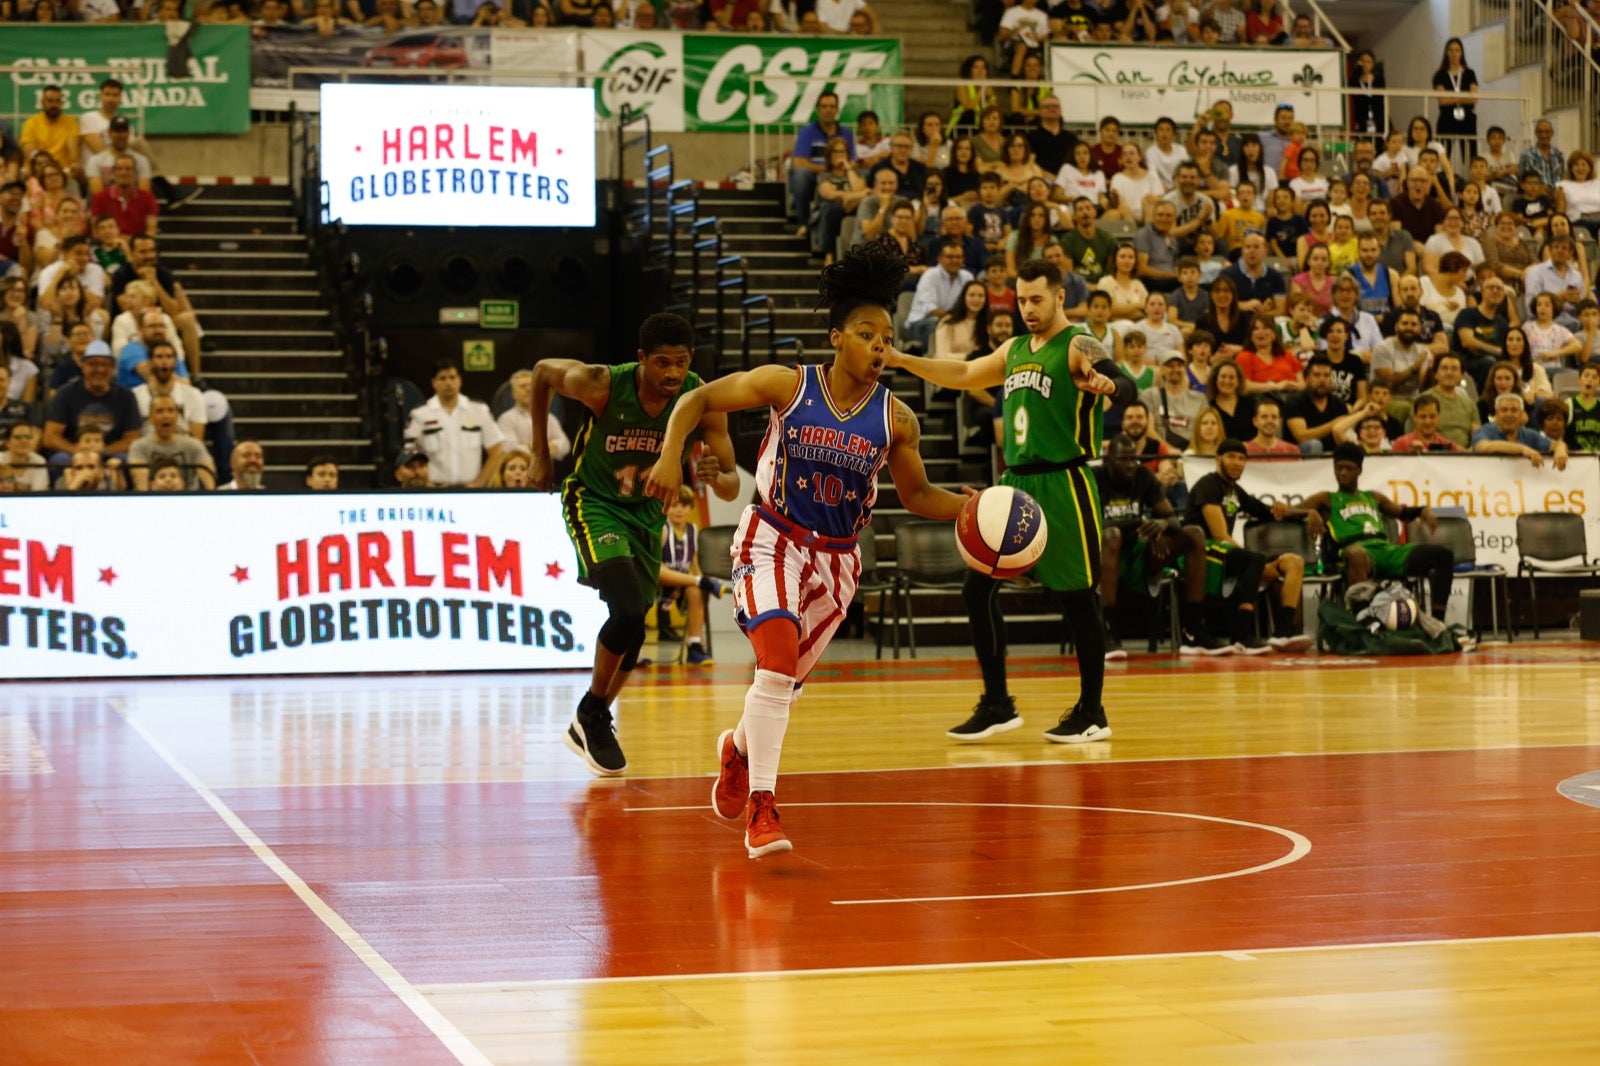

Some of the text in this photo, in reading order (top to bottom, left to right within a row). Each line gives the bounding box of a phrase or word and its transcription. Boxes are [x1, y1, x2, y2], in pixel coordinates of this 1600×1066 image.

[10, 56, 228, 86] CAJA RUAL
[607, 66, 677, 94] CSIF
[697, 44, 888, 123] CSIF
[1072, 51, 1279, 118] San Cayetano
[79, 86, 206, 110] GANADA
[383, 124, 538, 168] HARLEM
[351, 168, 570, 205] GLOBETROTTERS
[623, 429, 666, 440] WASHINGT
[799, 425, 872, 460] HARLEM
[1014, 405, 1028, 445] 9
[605, 435, 665, 454] GENERA
[812, 471, 843, 507] 10
[339, 507, 457, 524] THE ORIGINAL
[276, 530, 523, 601] HARLEM
